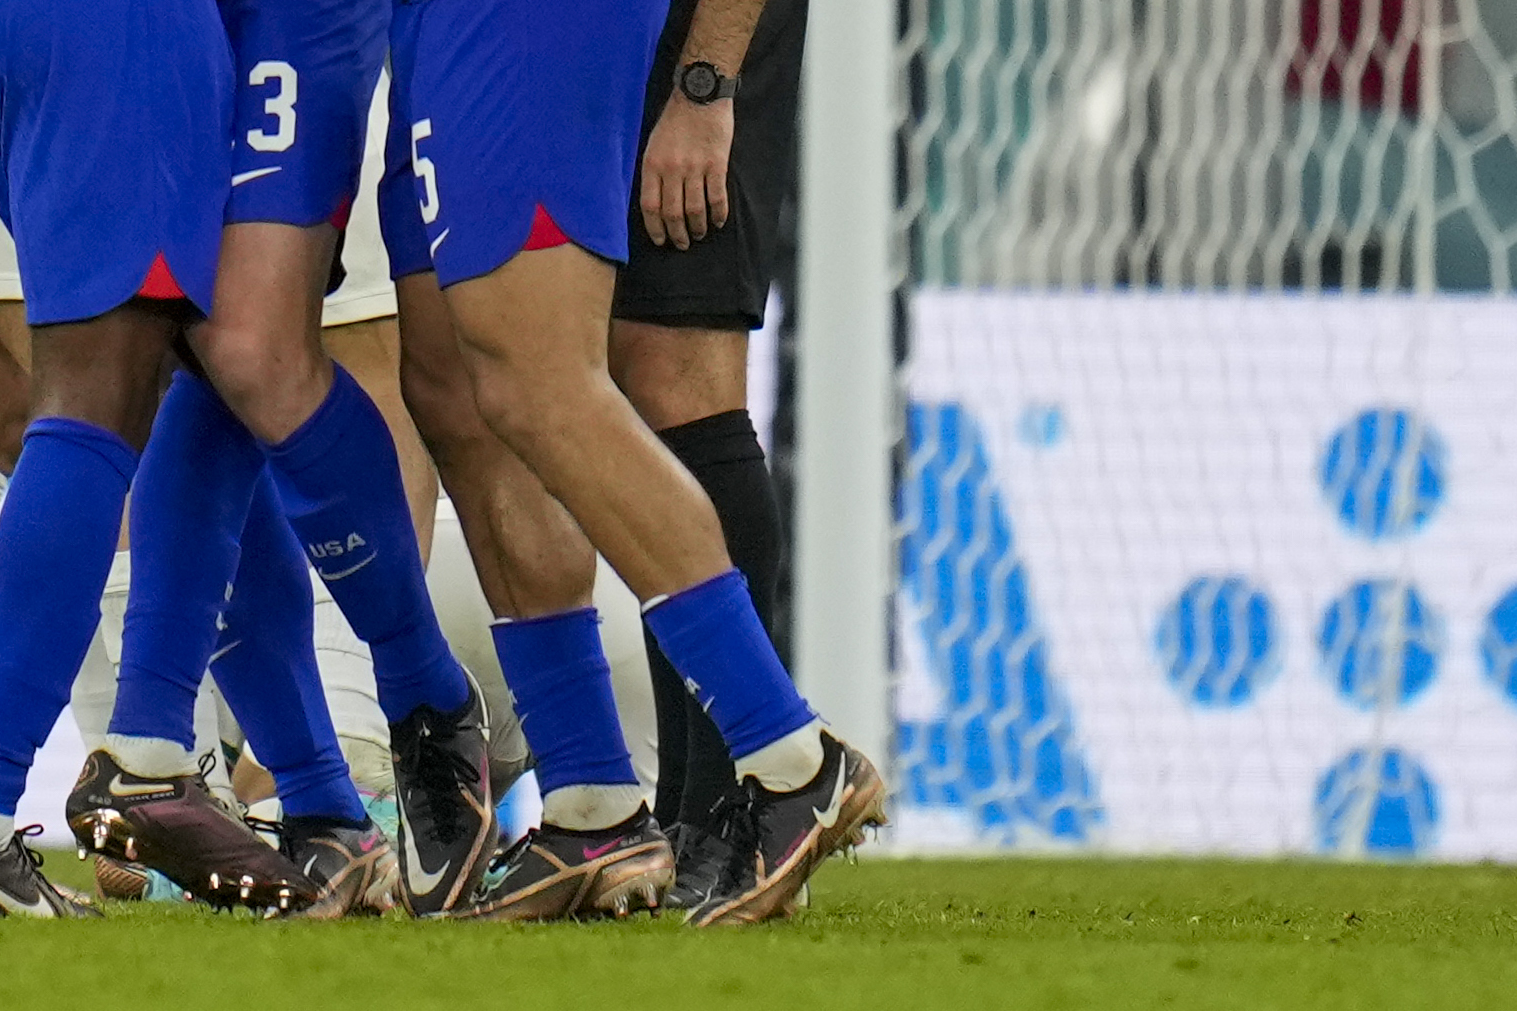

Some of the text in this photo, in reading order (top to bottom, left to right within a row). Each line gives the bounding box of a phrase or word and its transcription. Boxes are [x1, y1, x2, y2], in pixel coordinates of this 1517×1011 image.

[231, 60, 298, 152] 3
[411, 118, 440, 225] 5
[308, 532, 366, 558] USA
